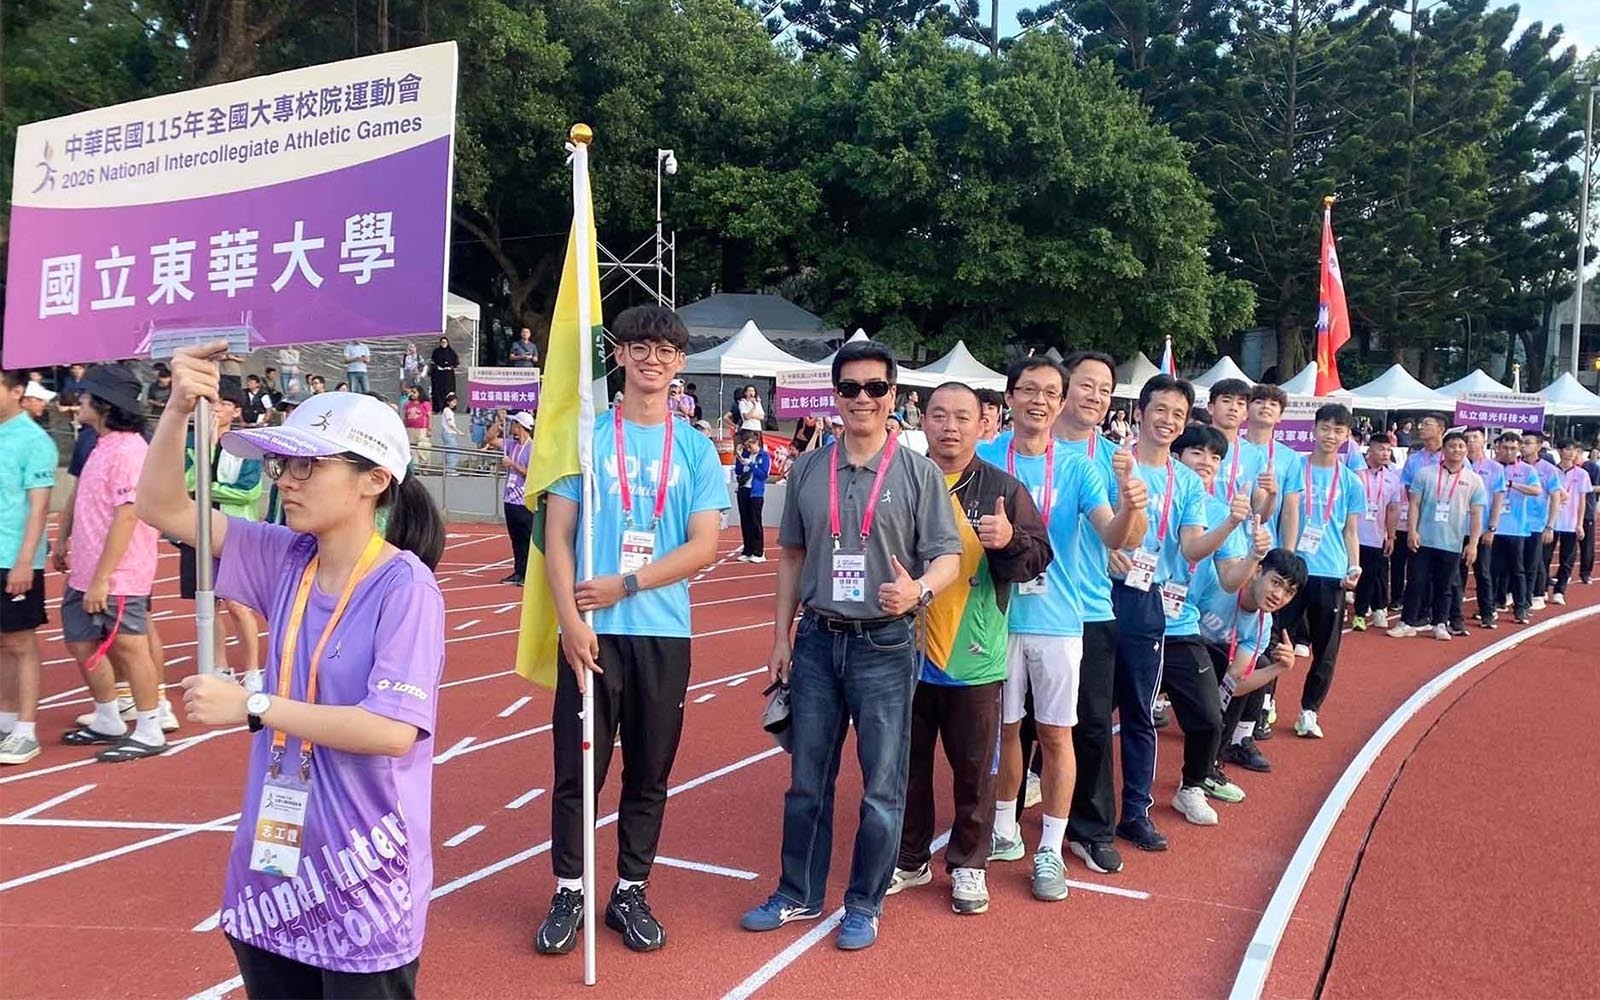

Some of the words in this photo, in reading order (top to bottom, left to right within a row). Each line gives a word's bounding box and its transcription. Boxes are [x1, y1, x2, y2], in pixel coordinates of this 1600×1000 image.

[61, 171, 95, 190] 2026
[99, 161, 160, 184] National
[164, 137, 280, 172] Intercollegiate
[284, 125, 352, 152] Athletic
[356, 115, 423, 141] Games
[64, 72, 423, 162] 中華民國115年全國大專校院運動會
[39, 211, 396, 319] 國立東華大學
[1458, 409, 1539, 425] 私立僑光科技大學
